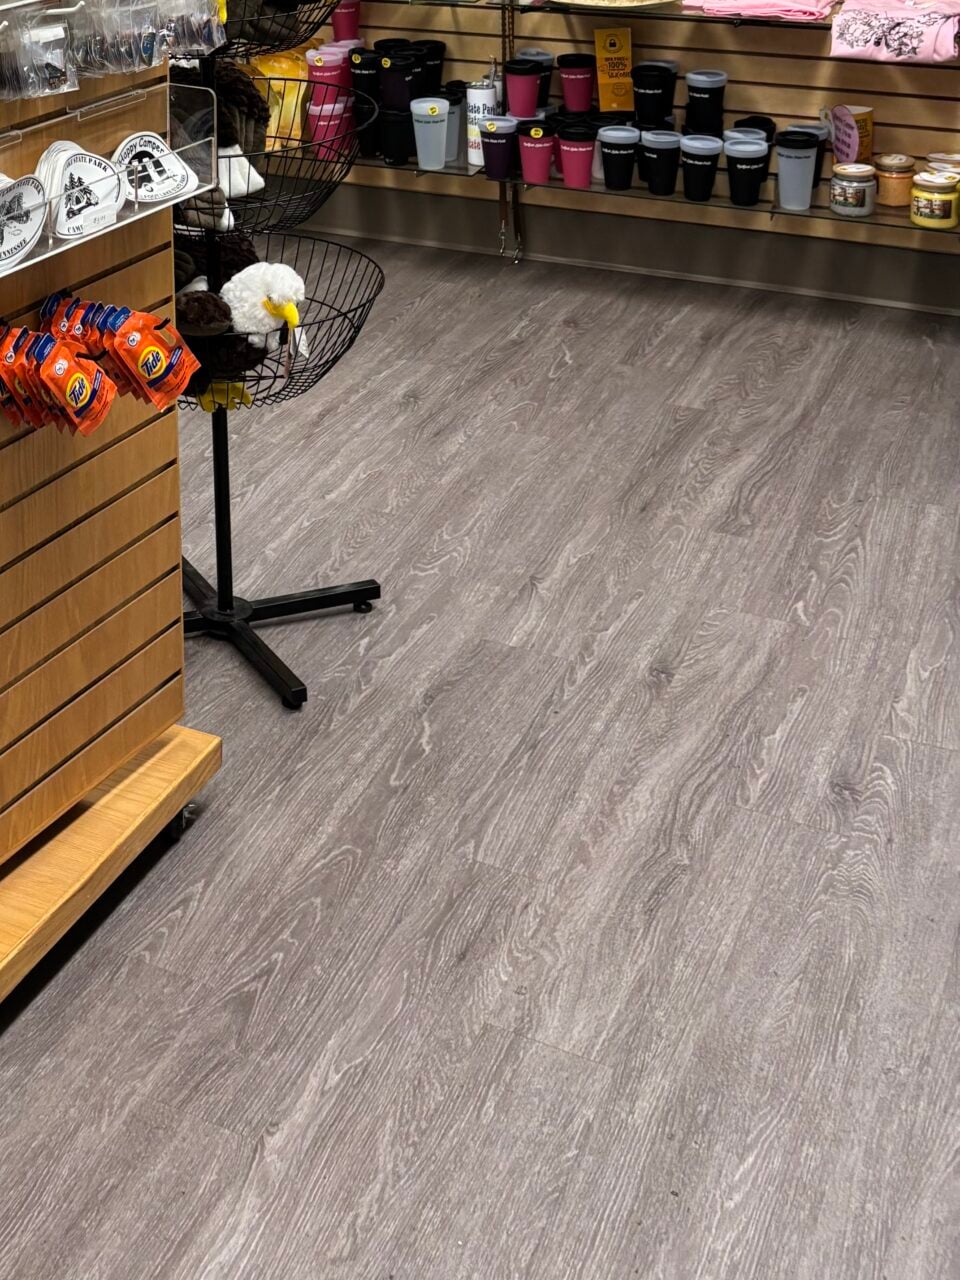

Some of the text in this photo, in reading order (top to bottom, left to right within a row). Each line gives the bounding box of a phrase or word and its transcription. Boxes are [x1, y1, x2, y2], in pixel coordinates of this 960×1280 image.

[138, 136, 165, 154] Camper
[88, 156, 108, 173] PARK
[30, 180, 42, 195] PARK
[141, 350, 162, 377] Tide
[67, 377, 86, 406] Tide
